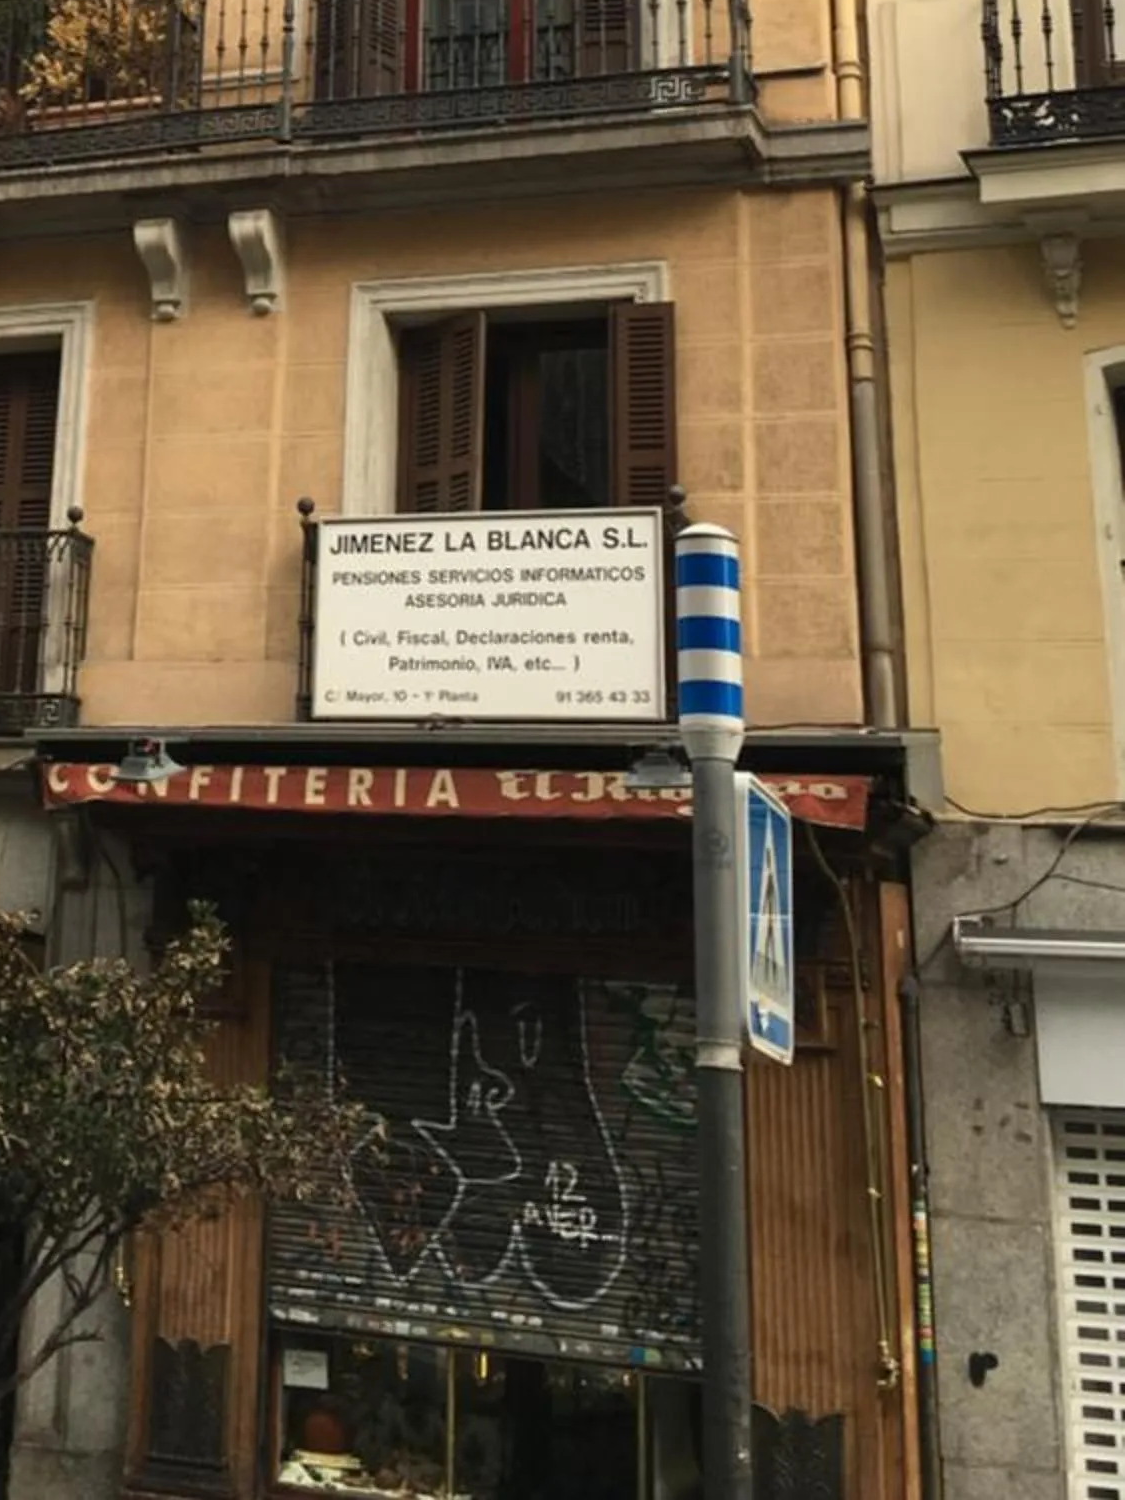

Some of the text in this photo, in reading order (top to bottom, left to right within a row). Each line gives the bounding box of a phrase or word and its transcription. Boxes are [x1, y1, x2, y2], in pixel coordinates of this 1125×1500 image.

[330, 526, 648, 555] JIMENEZ LA BLANCA S.L.
[332, 564, 646, 586] PENSIONES SERVICIOS INFORMATICOS
[405, 591, 568, 609] ASESORIA JURIDICA
[353, 629, 391, 647] Civil,
[397, 629, 449, 647] Fiscal,
[456, 629, 576, 645] Declaraciones
[583, 629, 635, 645] renta,
[389, 655, 481, 673] Patrimonio,
[487, 655, 518, 672] IVA,
[48, 763, 461, 809] CONFITERIA
